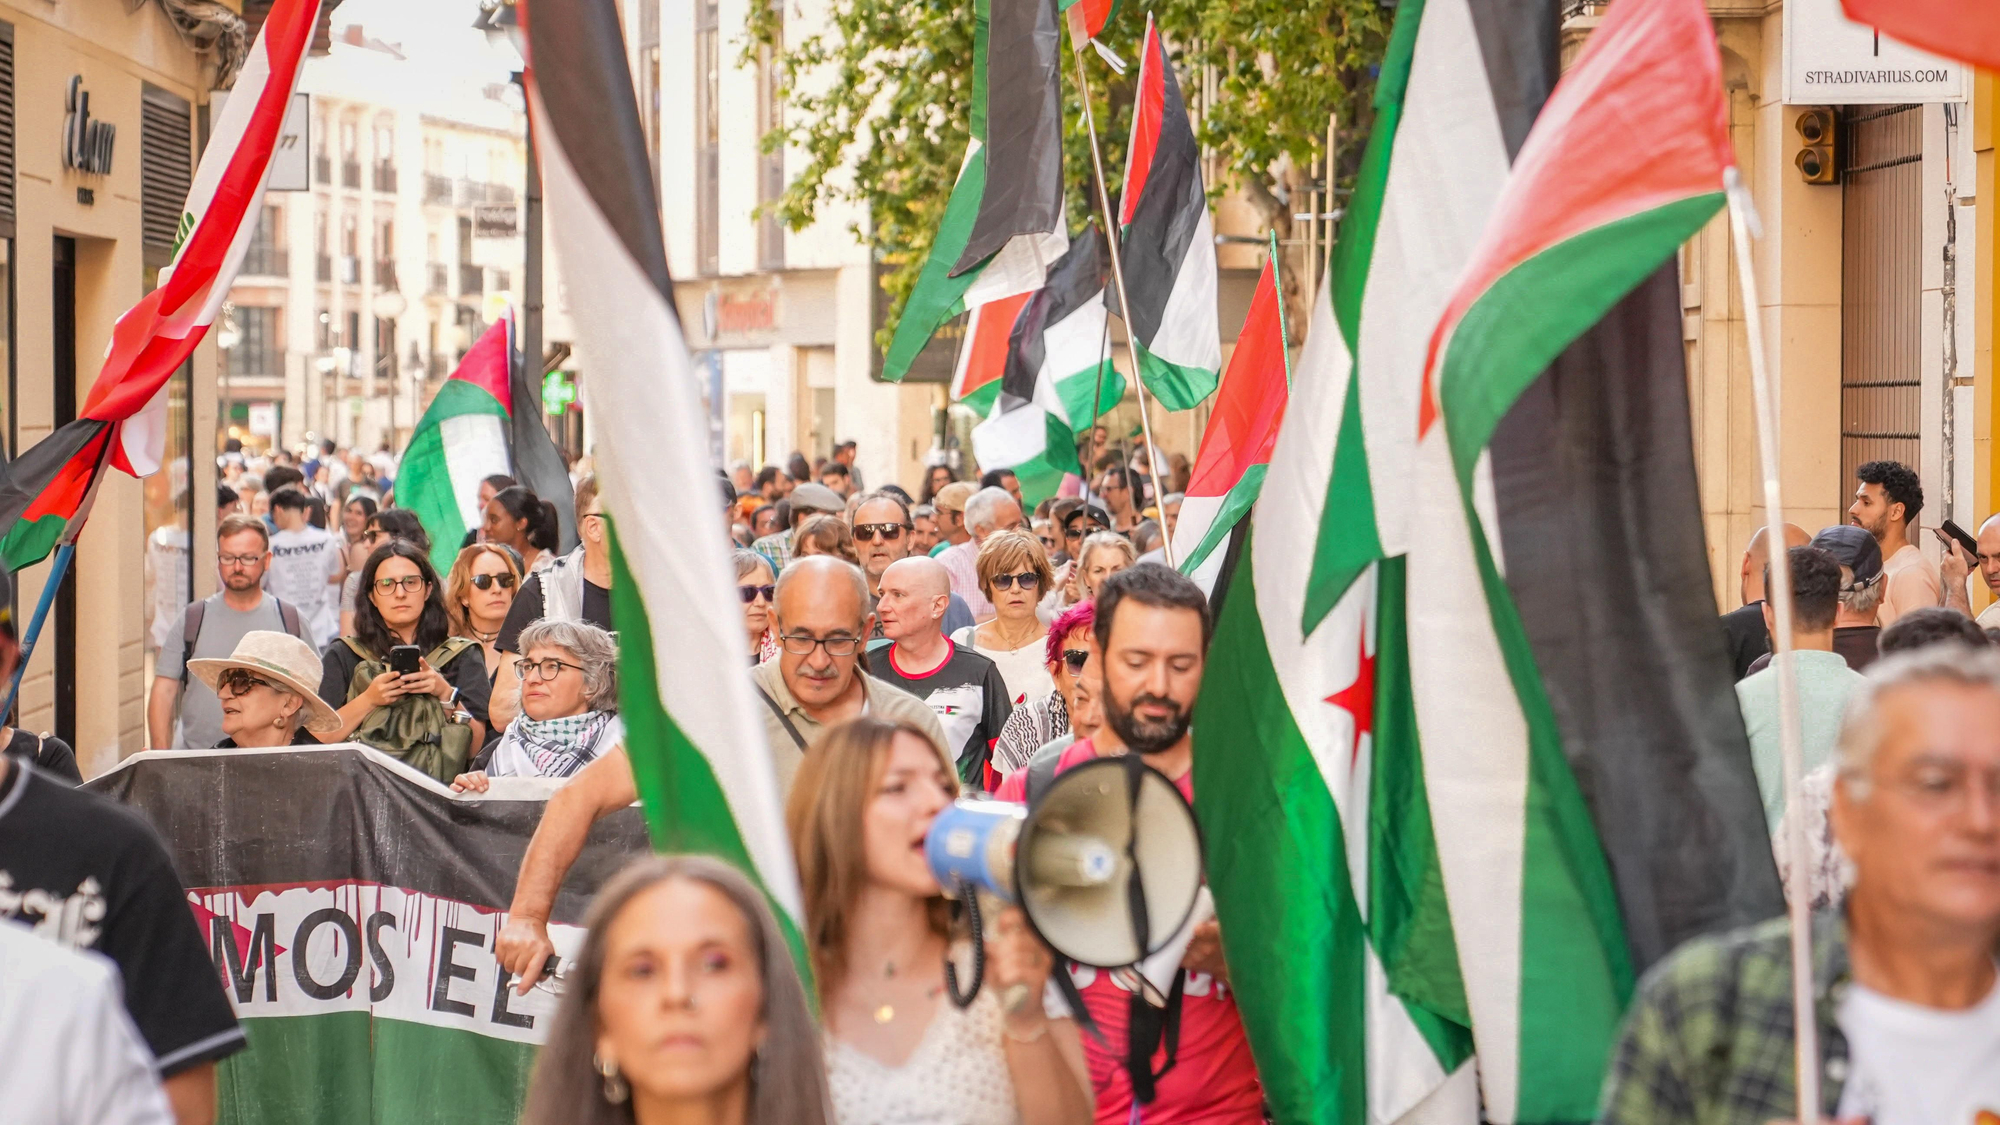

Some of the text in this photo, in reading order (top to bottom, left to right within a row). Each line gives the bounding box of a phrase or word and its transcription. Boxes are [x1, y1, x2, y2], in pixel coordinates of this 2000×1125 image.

[1805, 69, 1948, 84] STRADIVARIUS.COM
[272, 541, 326, 558] forever
[212, 907, 397, 1004] MOS
[432, 926, 535, 1029] EL
